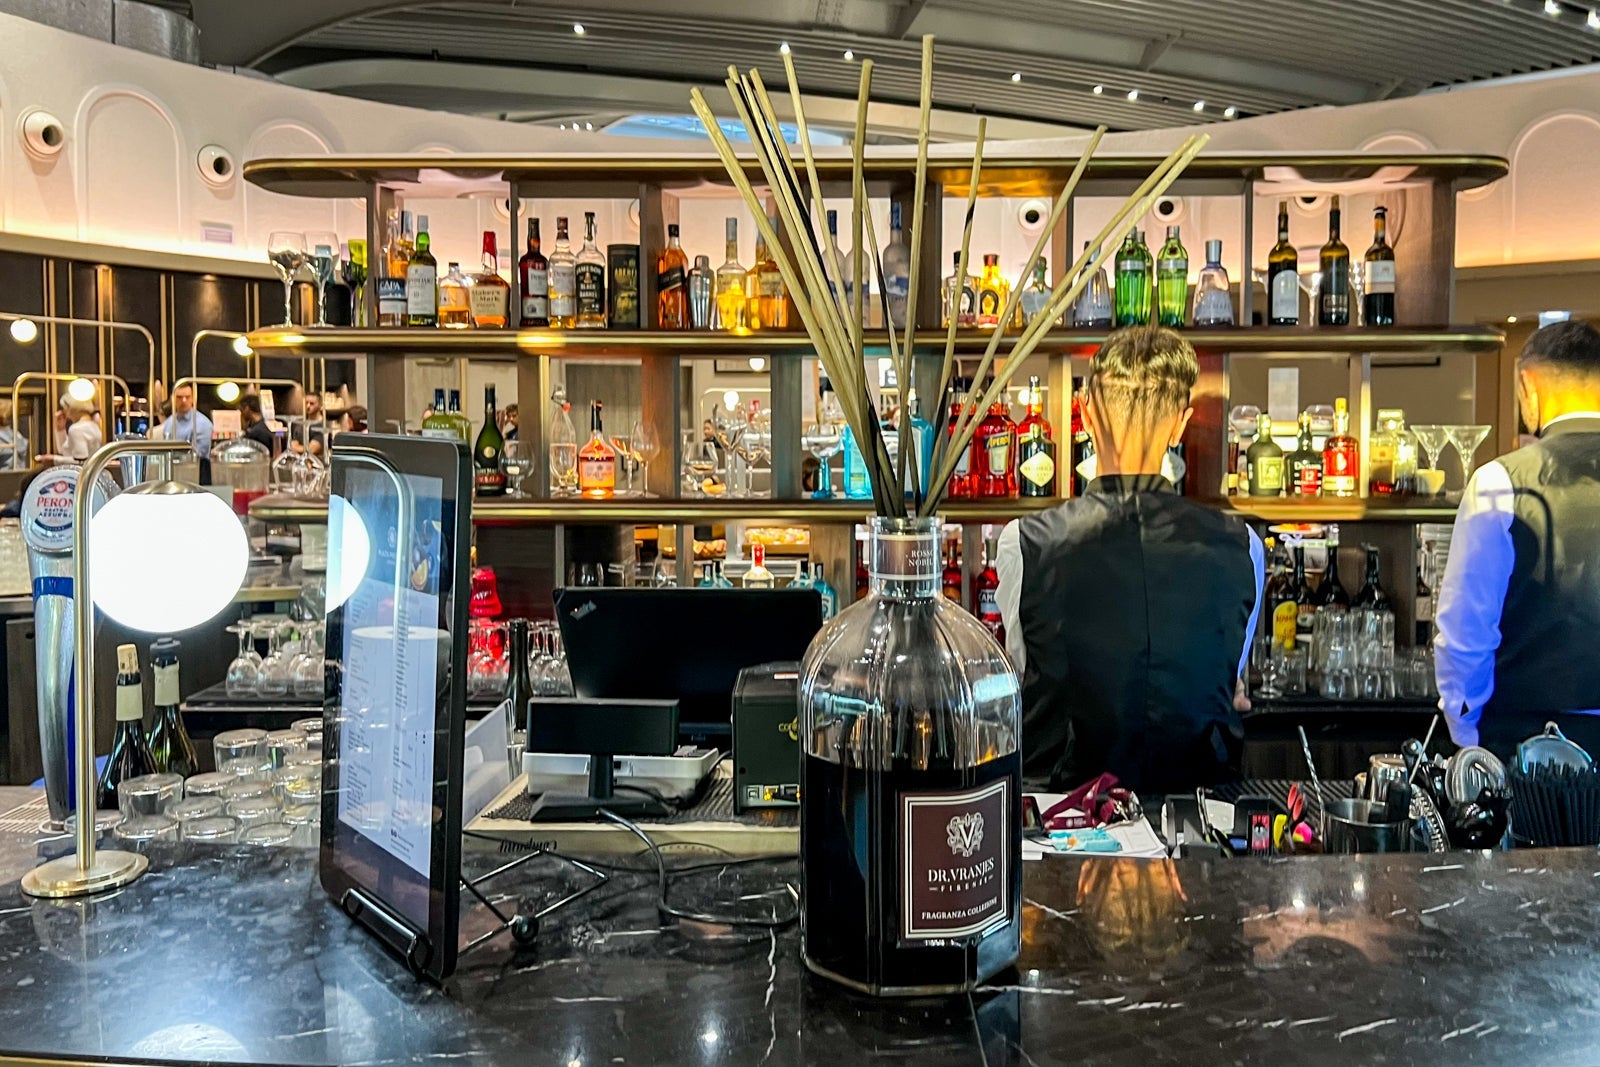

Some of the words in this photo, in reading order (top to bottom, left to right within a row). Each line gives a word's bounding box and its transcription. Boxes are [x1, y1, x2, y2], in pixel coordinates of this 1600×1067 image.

[576, 265, 602, 275] JAMESON
[987, 436, 1009, 448] APERO
[1305, 471, 1315, 481] 12
[36, 496, 74, 508] PERON
[908, 559, 934, 568] NOBIL
[940, 876, 988, 893] FIRENZE
[921, 910, 967, 920] FRAGRANZA
